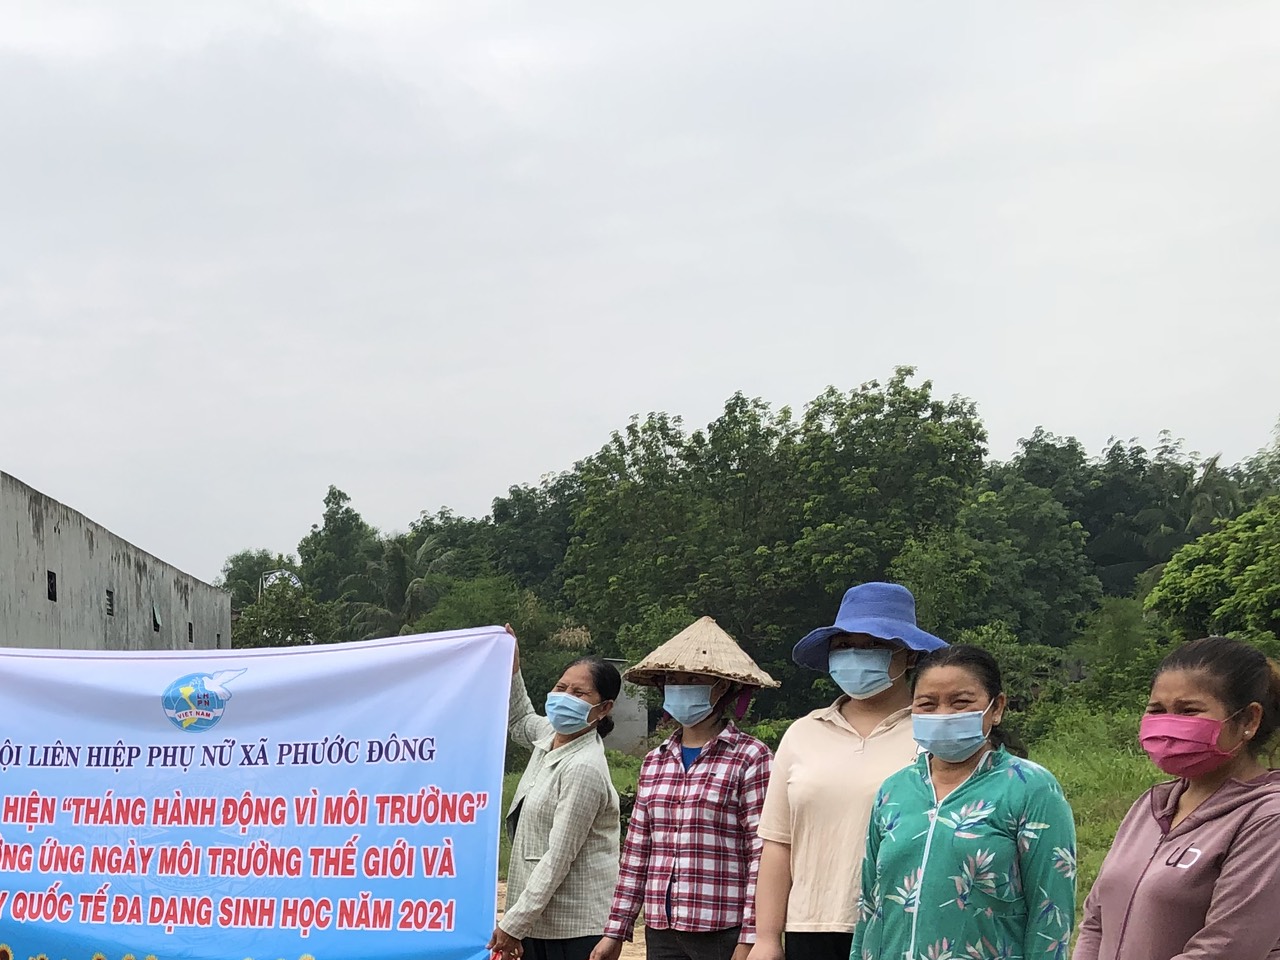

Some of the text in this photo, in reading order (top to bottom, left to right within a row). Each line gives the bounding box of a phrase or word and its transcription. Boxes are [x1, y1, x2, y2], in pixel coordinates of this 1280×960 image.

[195, 710, 211, 718] NAM
[27, 740, 82, 767] LIÊN
[85, 740, 141, 773] HIỆP
[146, 745, 195, 772] PHỤ
[199, 739, 236, 766] NỮ
[239, 738, 270, 766] XÃ
[276, 735, 360, 765] PHƯỚC
[366, 733, 436, 763] ĐÔNG
[2, 791, 56, 831] HIỆN
[62, 790, 146, 826] “THÁNG
[152, 790, 217, 826] HÀNH
[221, 791, 287, 834] ĐỘNG
[294, 789, 318, 826] VÌ
[323, 789, 368, 825] MÔI
[375, 786, 487, 825] TRƯỜNG”
[38, 838, 85, 873] ỨNG
[90, 839, 154, 874] NGÀY
[158, 841, 201, 875] MÔI
[207, 840, 302, 876] TRƯỜNG
[309, 835, 359, 876] THẾ
[363, 838, 415, 876] GIỚI
[422, 838, 455, 876] VÀ
[11, 882, 73, 921] QUỐC
[79, 883, 110, 922] TẾ
[112, 895, 142, 923] ĐA
[148, 896, 212, 933] DẠNG
[219, 897, 276, 927] SINH
[281, 898, 332, 936] HỌC
[337, 892, 393, 928] NĂM
[398, 900, 455, 930] 2021
